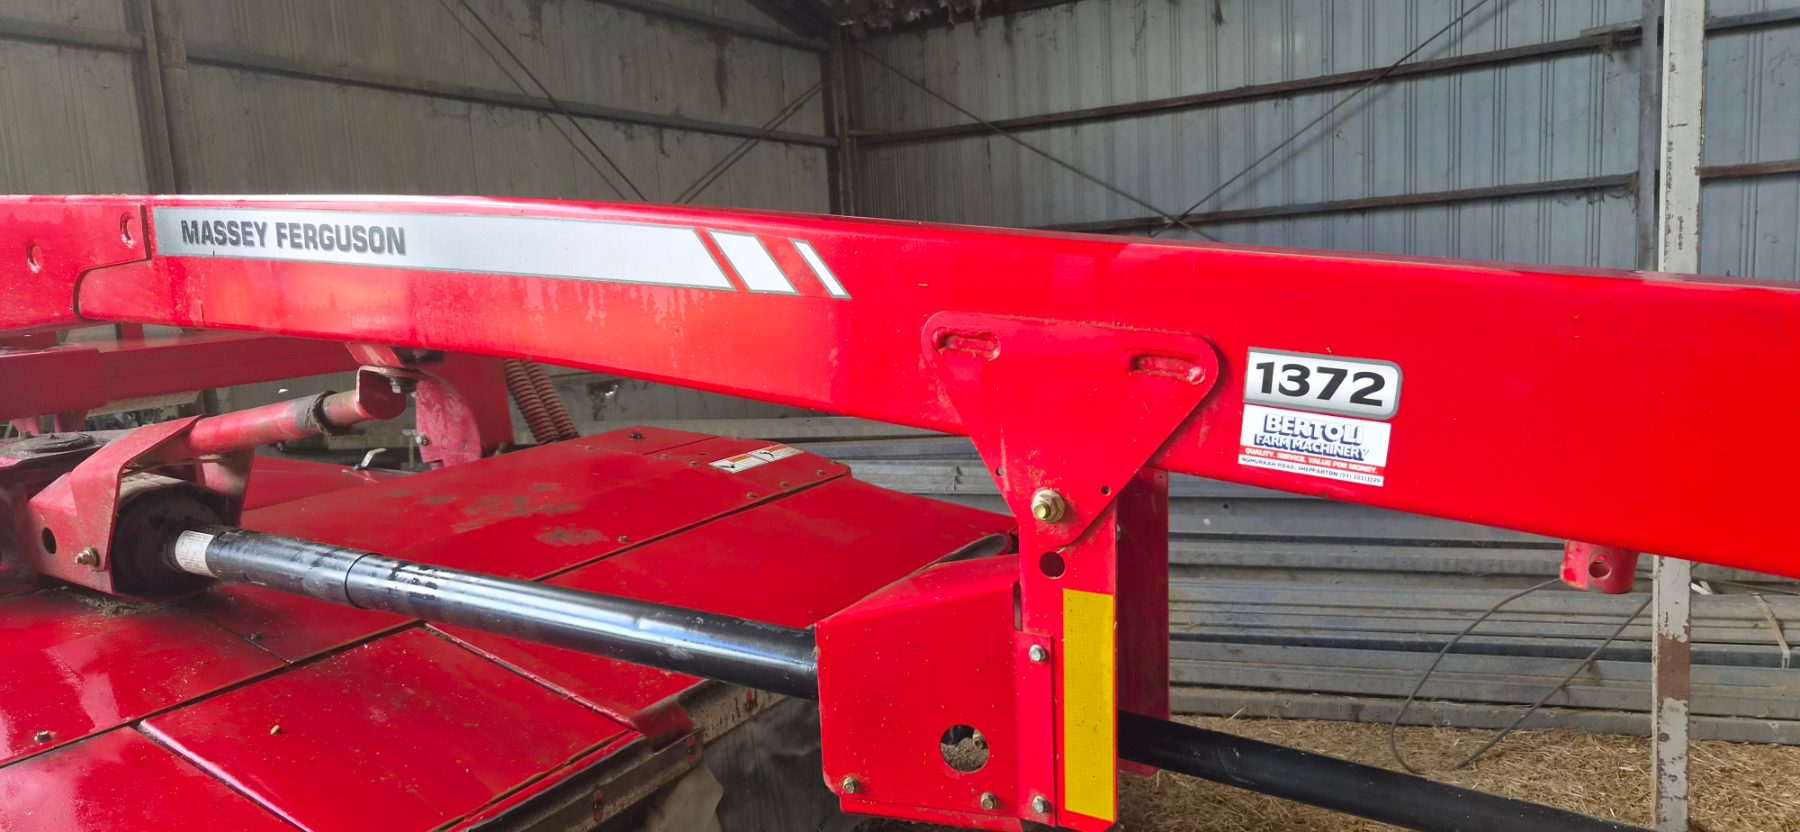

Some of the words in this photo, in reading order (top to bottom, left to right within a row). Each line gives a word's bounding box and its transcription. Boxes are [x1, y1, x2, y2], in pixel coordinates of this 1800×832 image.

[180, 220, 268, 247] MASSEY
[275, 222, 407, 256] FERGUSON
[1256, 361, 1386, 407] 1372
[1264, 413, 1365, 446] BERTOLI
[1254, 434, 1290, 450] FARM
[1290, 438, 1370, 461] MACHINERY
[1308, 457, 1333, 467] VALUE
[1332, 460, 1348, 470] FOR
